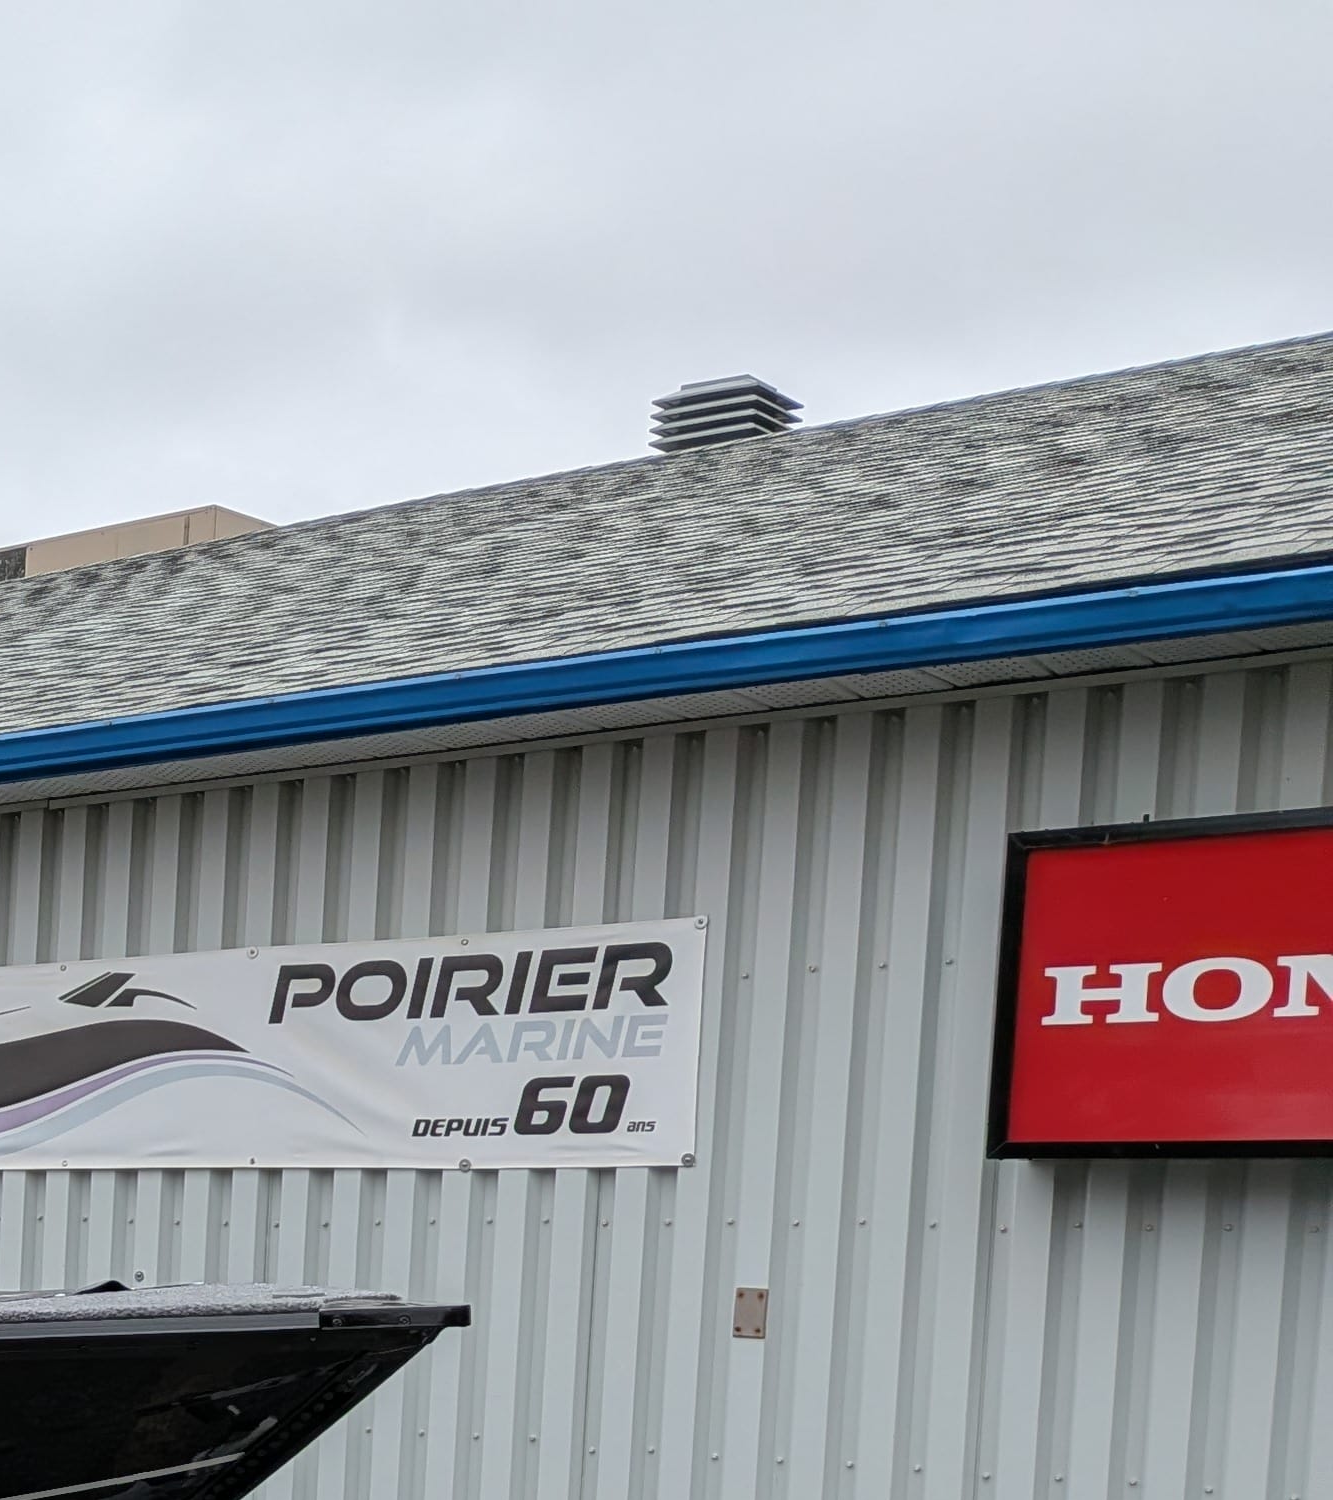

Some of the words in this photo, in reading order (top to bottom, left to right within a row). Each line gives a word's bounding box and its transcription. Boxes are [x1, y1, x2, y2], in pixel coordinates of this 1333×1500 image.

[267, 941, 674, 1024] POIRIER
[394, 1013, 670, 1067] MARINE
[411, 1116, 510, 1137] DEPUIS
[513, 1073, 631, 1136] 60
[626, 1120, 656, 1133] ans
